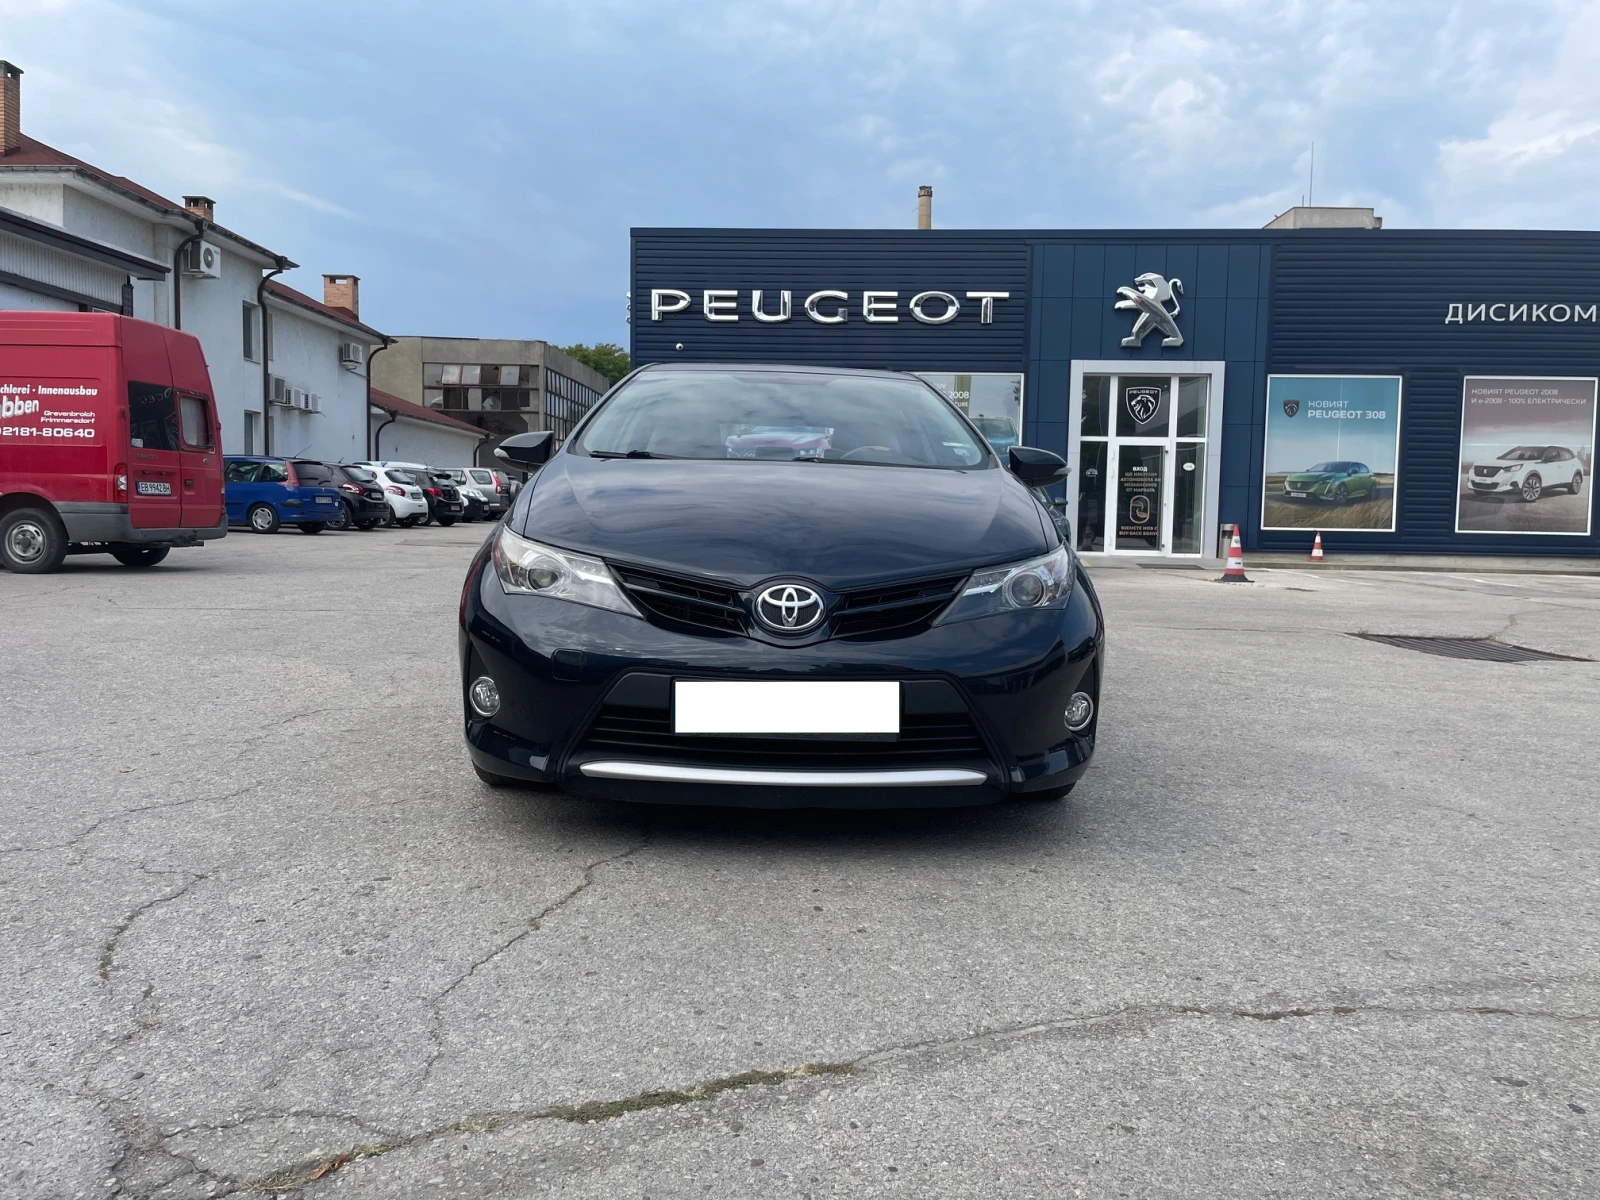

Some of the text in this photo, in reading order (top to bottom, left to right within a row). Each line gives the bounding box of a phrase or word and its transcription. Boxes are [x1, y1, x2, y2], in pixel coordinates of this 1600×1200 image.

[651, 290, 1011, 323] PEUGEOT
[1445, 303, 1597, 324] ДИСИКОМ
[38, 384, 98, 396] Innenausbau
[948, 391, 970, 399] 2008
[0, 395, 40, 418] bben
[1308, 400, 1349, 408] НОВИЯТ
[40, 416, 95, 424] Frimmersdorf
[1307, 410, 1386, 420] PEUGEOT 308
